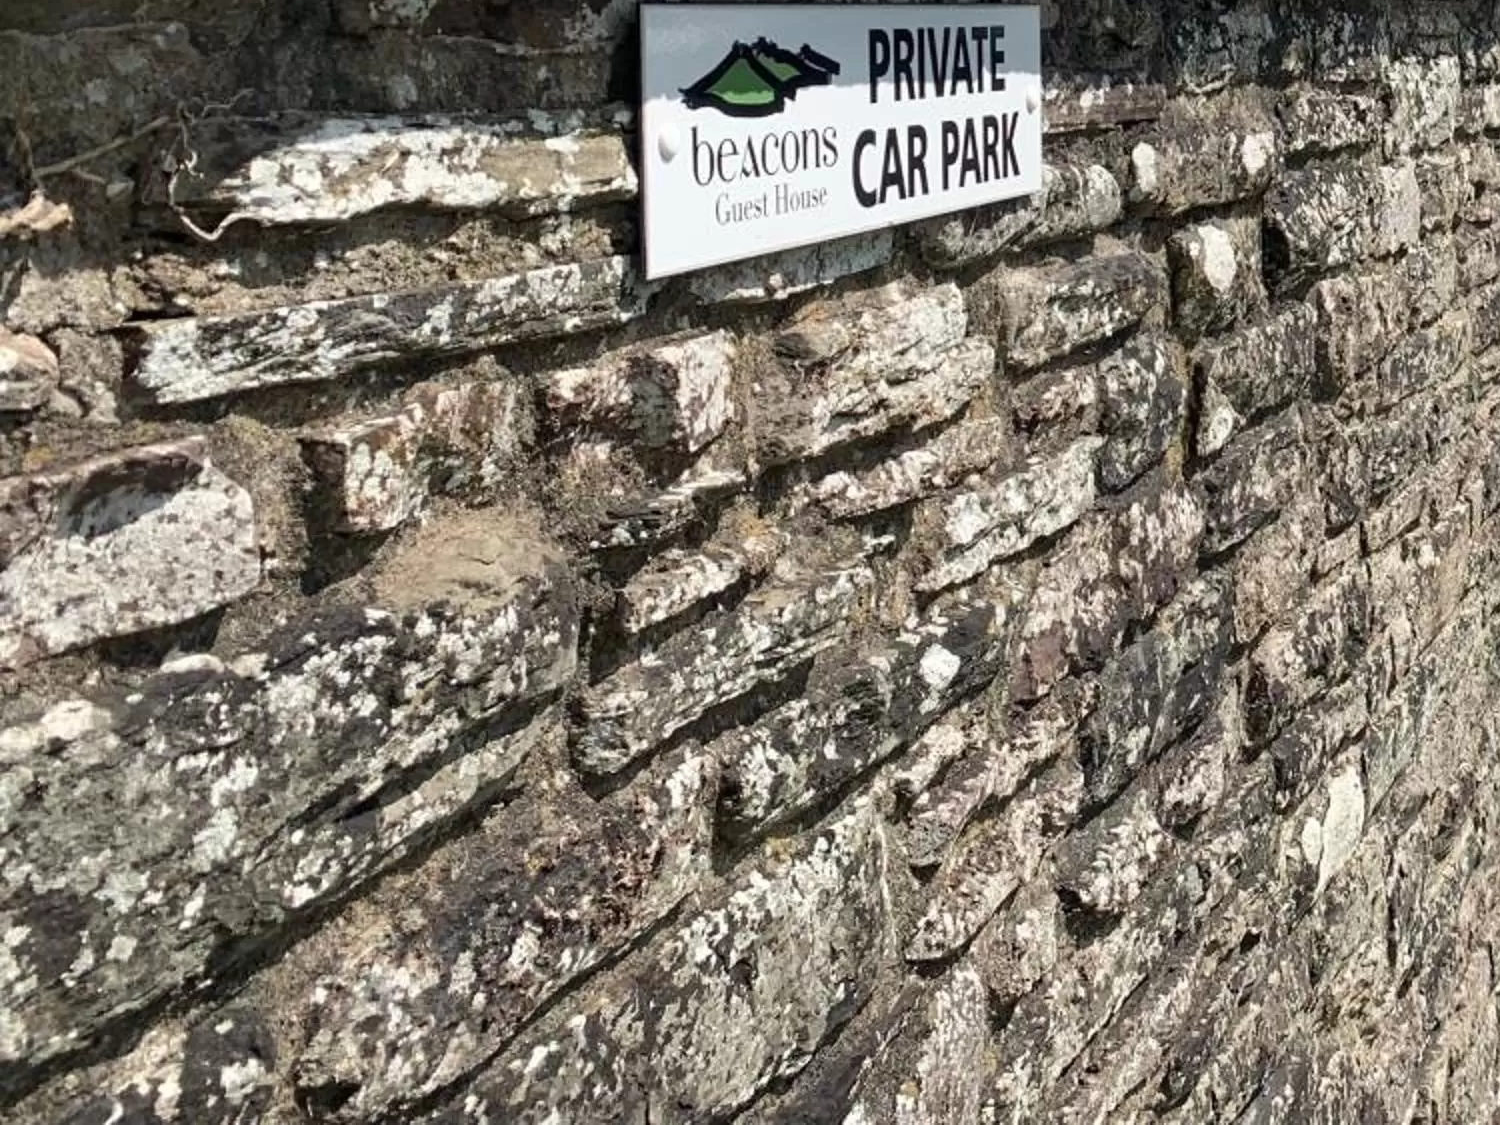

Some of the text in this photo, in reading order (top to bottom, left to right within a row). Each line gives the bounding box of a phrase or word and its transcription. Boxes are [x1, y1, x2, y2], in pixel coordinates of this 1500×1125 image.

[868, 25, 1005, 104] PRIVATE
[691, 125, 838, 186] beacons
[852, 111, 1021, 208] CAR PARK
[715, 183, 828, 225] Guest House
